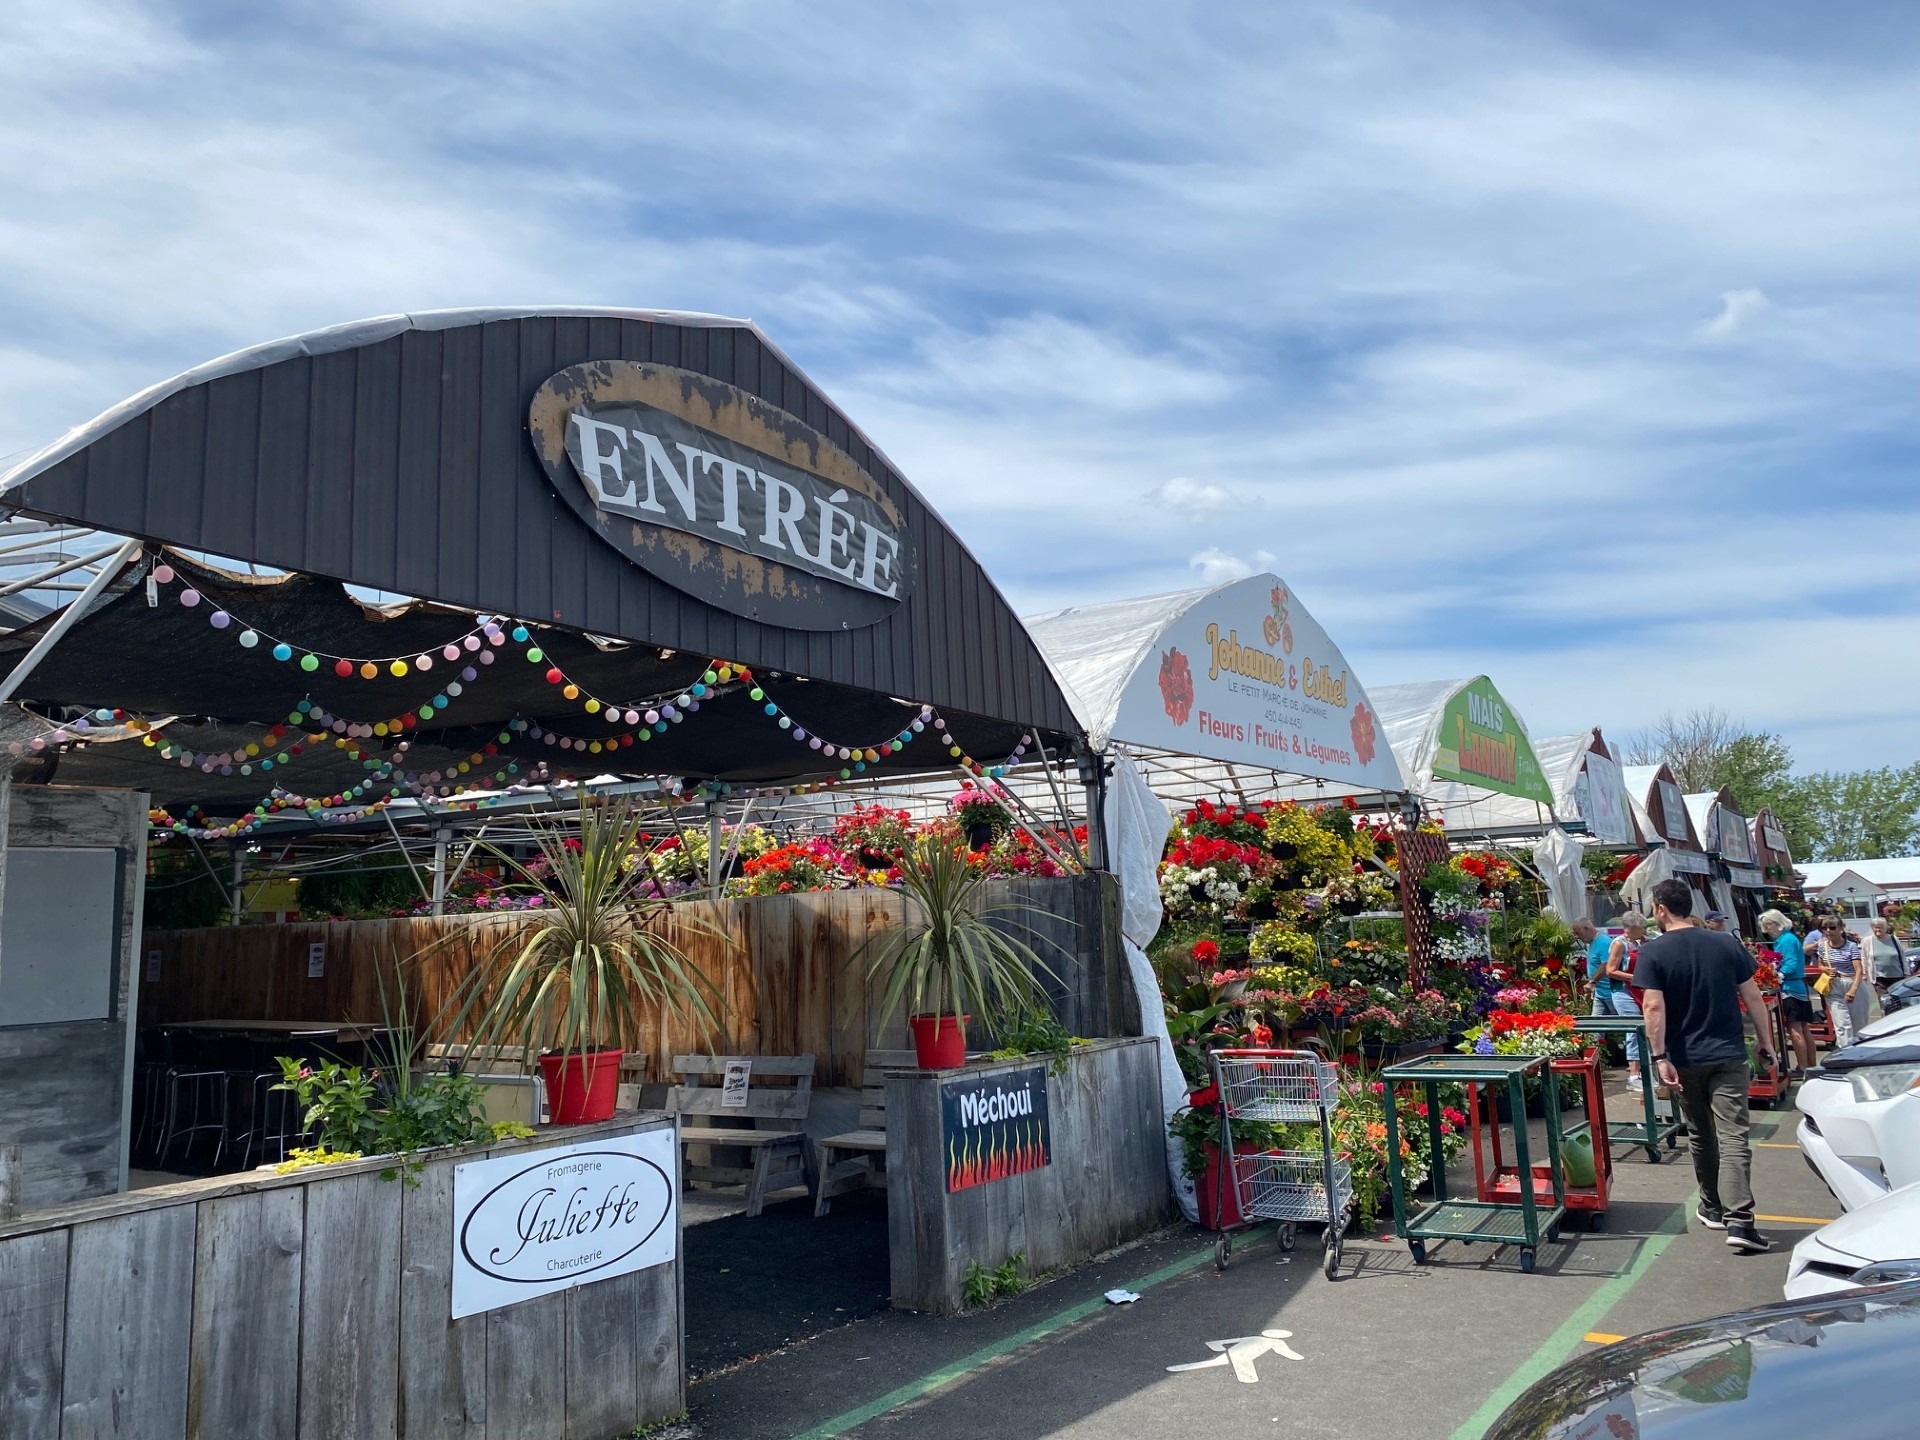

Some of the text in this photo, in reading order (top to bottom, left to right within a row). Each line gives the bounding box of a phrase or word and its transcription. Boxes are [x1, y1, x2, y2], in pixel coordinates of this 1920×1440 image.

[571, 413, 899, 598] ENTRÉE
[1206, 623, 1285, 689] Johanne
[1288, 664, 1298, 691] &
[1228, 679, 1238, 692] LE
[1241, 683, 1260, 699] PETIT
[1290, 699, 1299, 711] DE
[1300, 703, 1328, 719] JOHANNE
[1467, 691, 1504, 734] MAÏS
[1199, 711, 1244, 742] Fleurs
[1255, 724, 1289, 752] Fruits
[1292, 735, 1302, 755] &
[1304, 737, 1351, 766] Légumes
[960, 1082, 1033, 1128] Méchoui
[547, 1160, 602, 1181] Fromagerie
[490, 1182, 639, 1265] Juliette
[546, 1249, 602, 1271] Charcuterie
